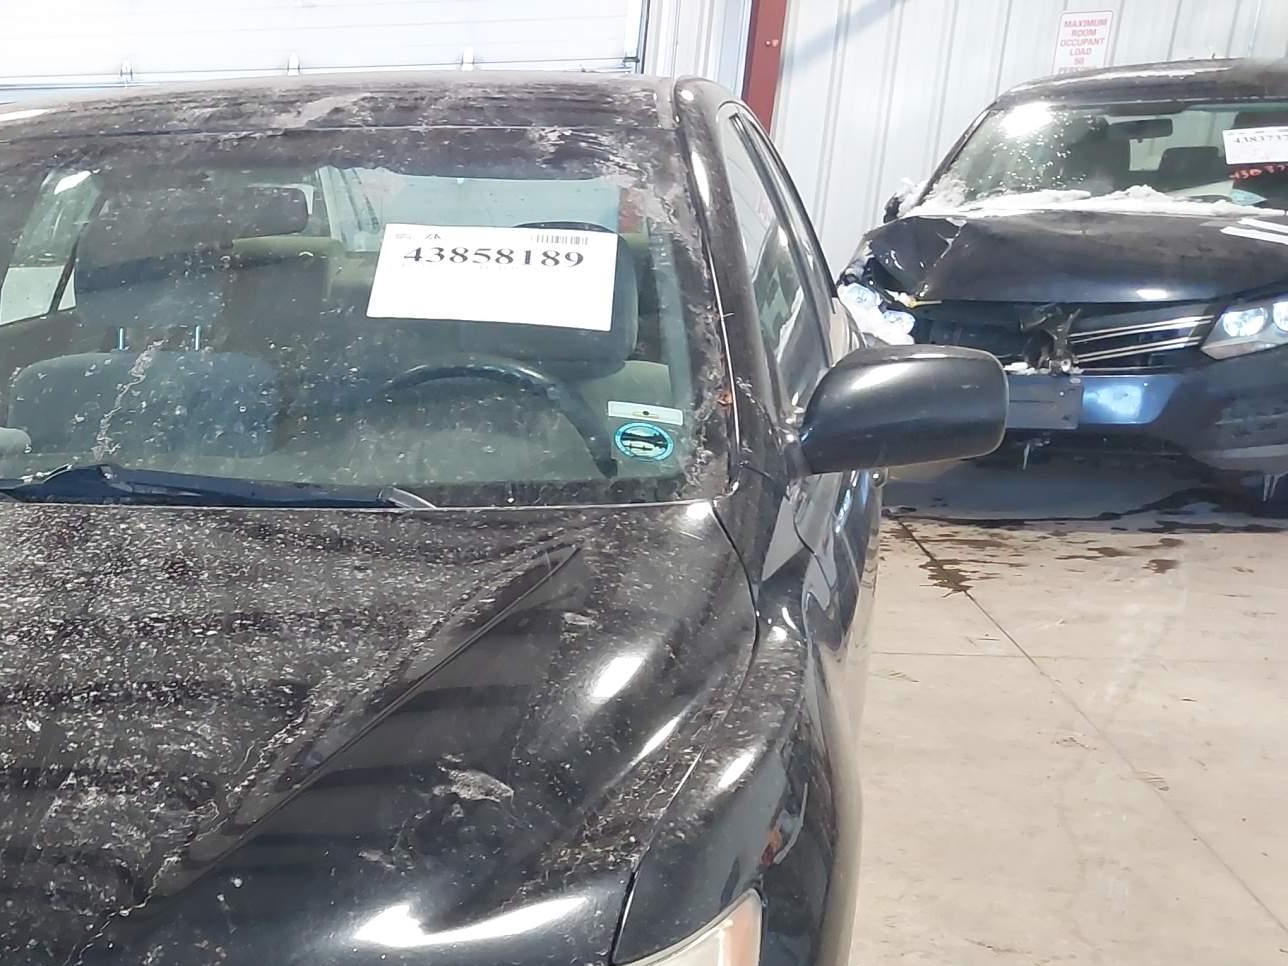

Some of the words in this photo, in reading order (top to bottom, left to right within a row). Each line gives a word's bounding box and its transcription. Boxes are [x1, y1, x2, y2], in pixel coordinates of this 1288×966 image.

[1063, 19, 1108, 27] MAXIMUM
[1072, 29, 1097, 37] ROOM
[1060, 38, 1105, 47] OCCUPANT
[1070, 48, 1092, 56] LOAD
[403, 247, 584, 267] 43858189
